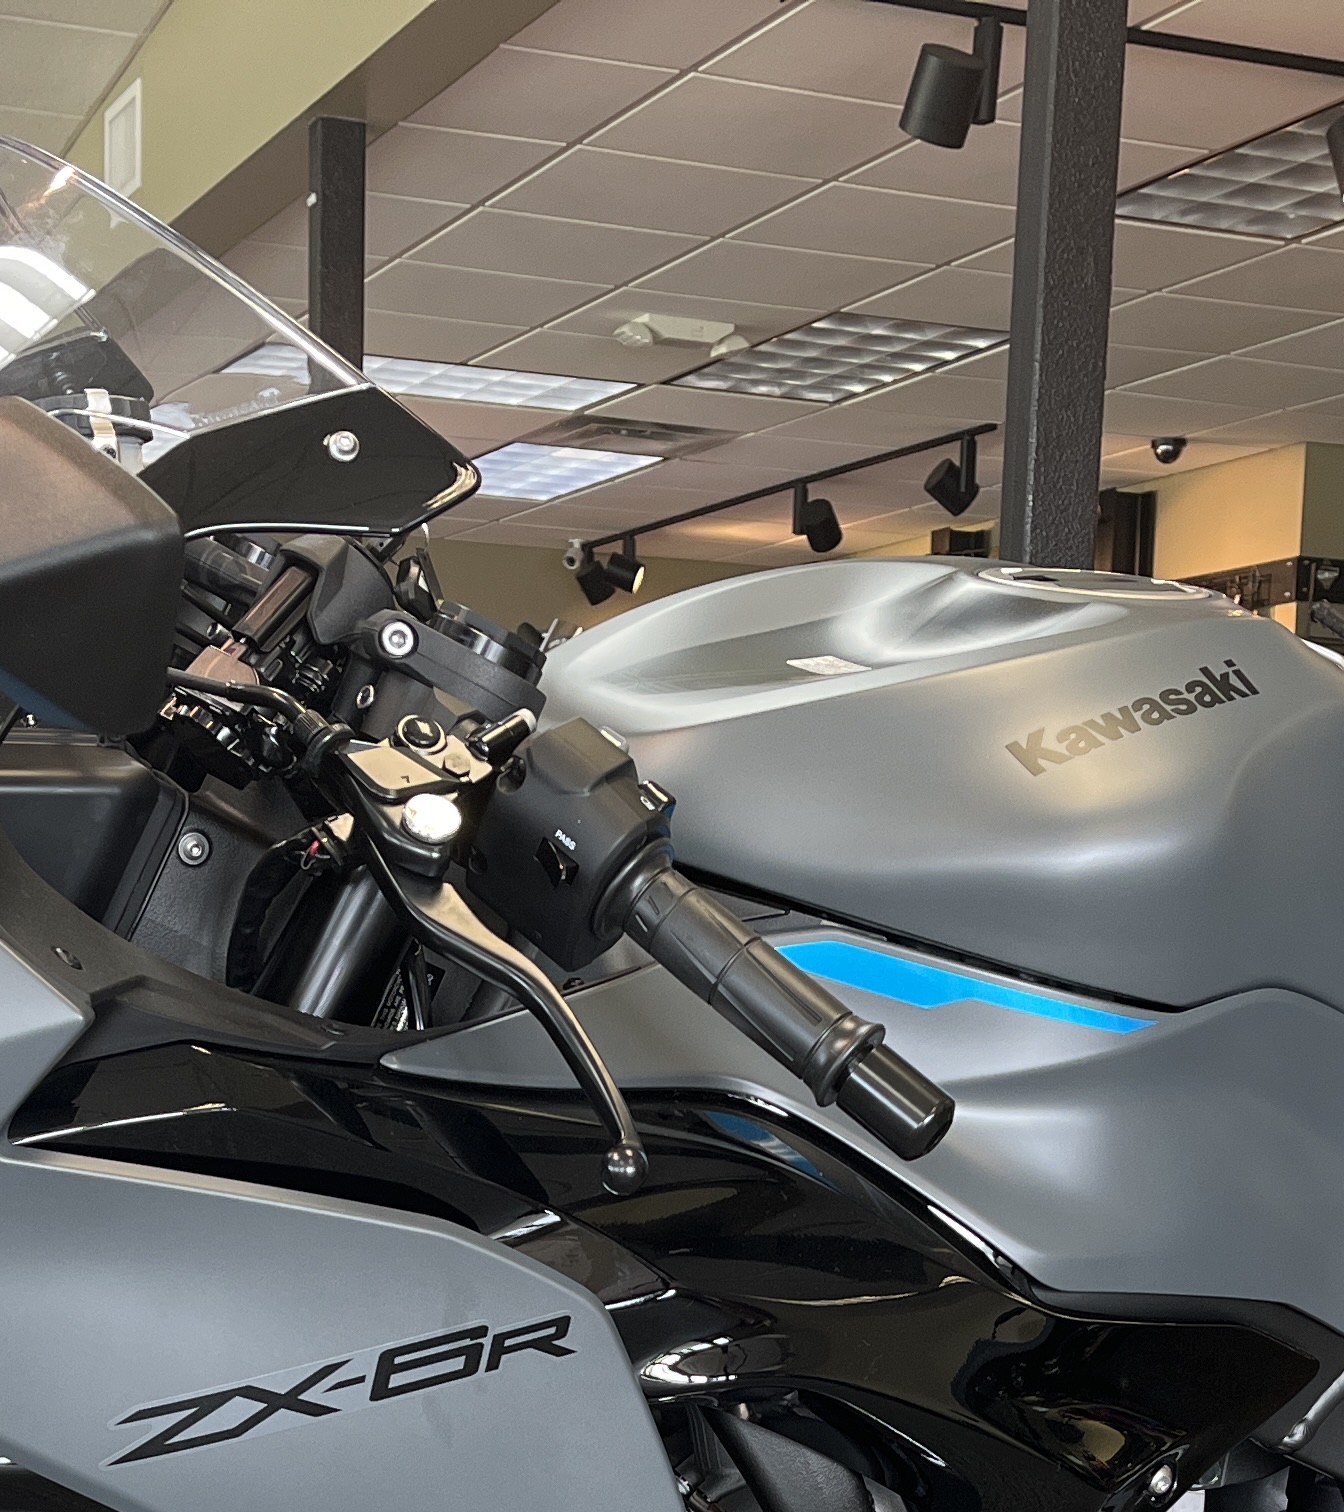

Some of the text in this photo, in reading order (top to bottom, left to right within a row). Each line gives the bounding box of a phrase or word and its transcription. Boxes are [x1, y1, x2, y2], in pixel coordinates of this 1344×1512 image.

[1005, 659, 1260, 777] Kawasaki
[555, 829, 577, 851] PASS
[106, 1315, 578, 1467] ZX-6R
